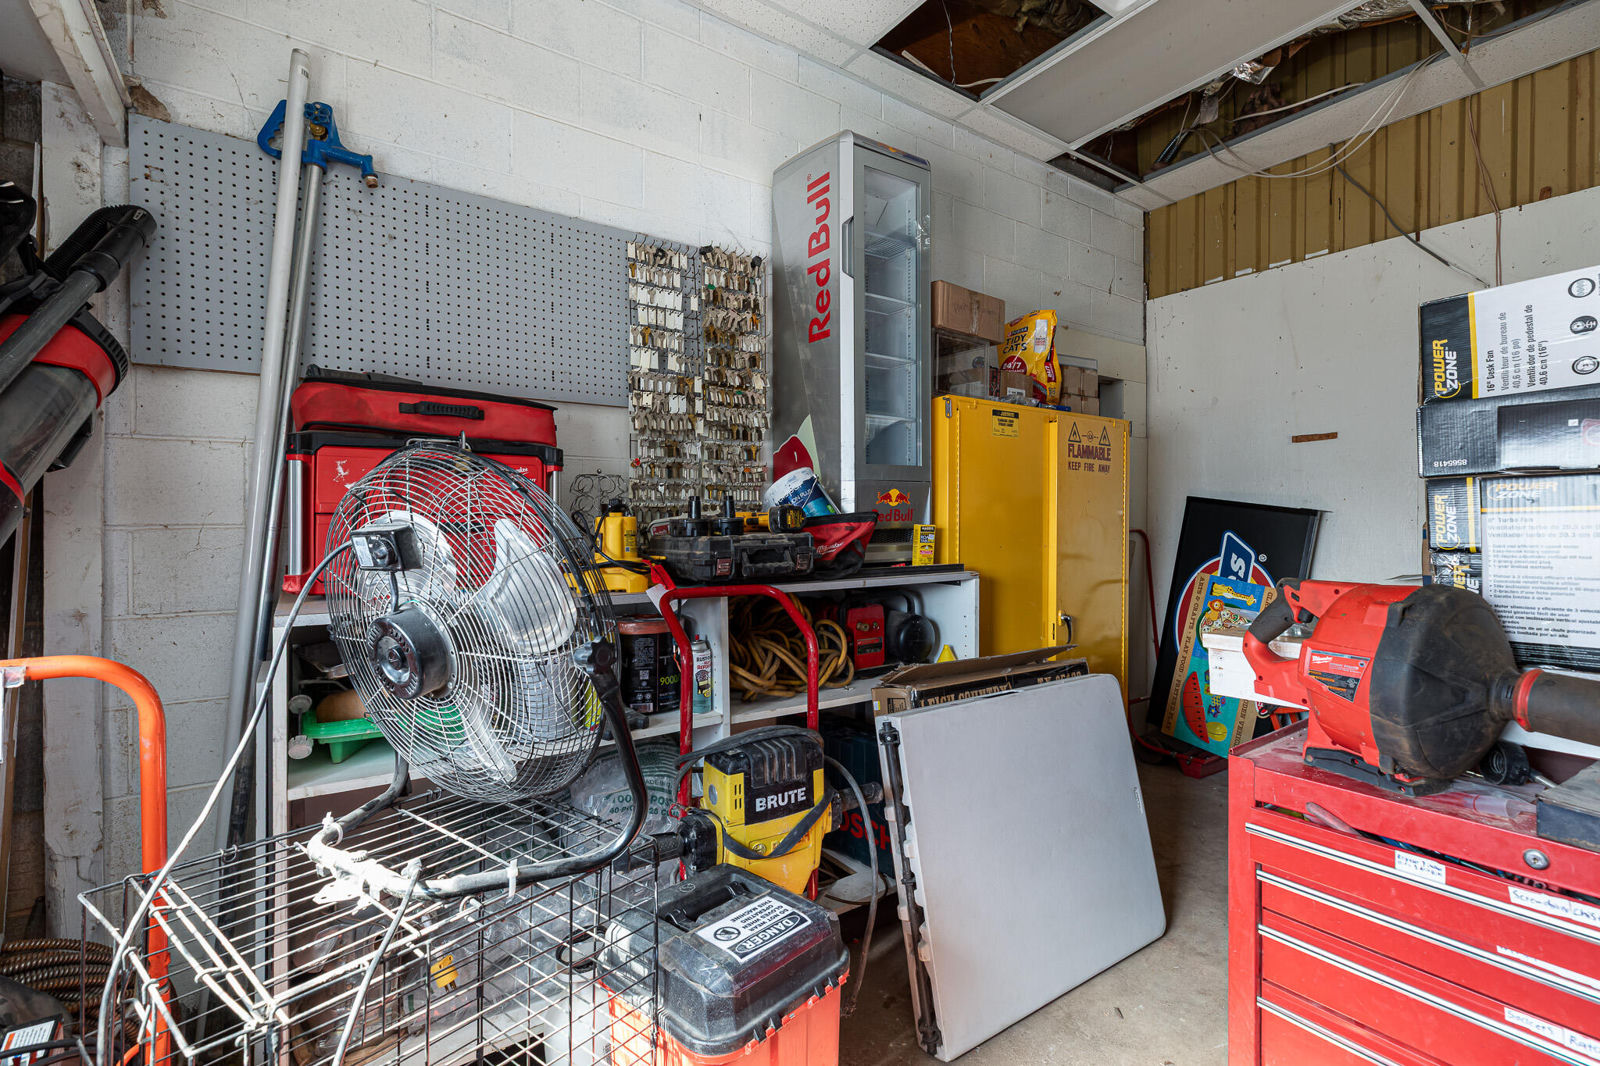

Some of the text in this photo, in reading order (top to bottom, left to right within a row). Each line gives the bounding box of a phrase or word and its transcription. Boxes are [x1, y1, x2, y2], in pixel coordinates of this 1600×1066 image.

[806, 171, 831, 344] Red Bull
[1498, 312, 1506, 321] de
[1524, 304, 1533, 313] de
[1499, 322, 1508, 345] bureau
[1524, 315, 1535, 343] pedestal
[1006, 333, 1027, 345] TIDY
[1003, 342, 1028, 354] CATS
[1485, 350, 1494, 362] Fan
[1499, 346, 1508, 355] de
[1526, 344, 1535, 353] de
[1432, 339, 1448, 395] POWER
[1445, 350, 1459, 390] ZONE
[1486, 363, 1495, 379] Desk
[1068, 443, 1112, 462] FLAMMABLE
[1068, 461, 1110, 473] KEEP FIRE AWAY
[1494, 481, 1558, 492] POWER
[1494, 490, 1542, 499] ZONE
[894, 508, 915, 522] Bull
[1434, 494, 1449, 544] POWER
[1446, 505, 1458, 543] ZONE
[1197, 577, 1205, 594] ARTS
[1189, 603, 1199, 629] CRAFTS
[1183, 636, 1191, 655] PLAY
[1179, 656, 1187, 673] FOOD
[755, 786, 807, 813] BRUTE
[729, 906, 758, 922] MACHINE
[740, 905, 773, 924] OPERATING
[742, 905, 783, 929] GLOVES WHEN
[741, 917, 794, 950] DANGER
[748, 920, 767, 931] WEAR
